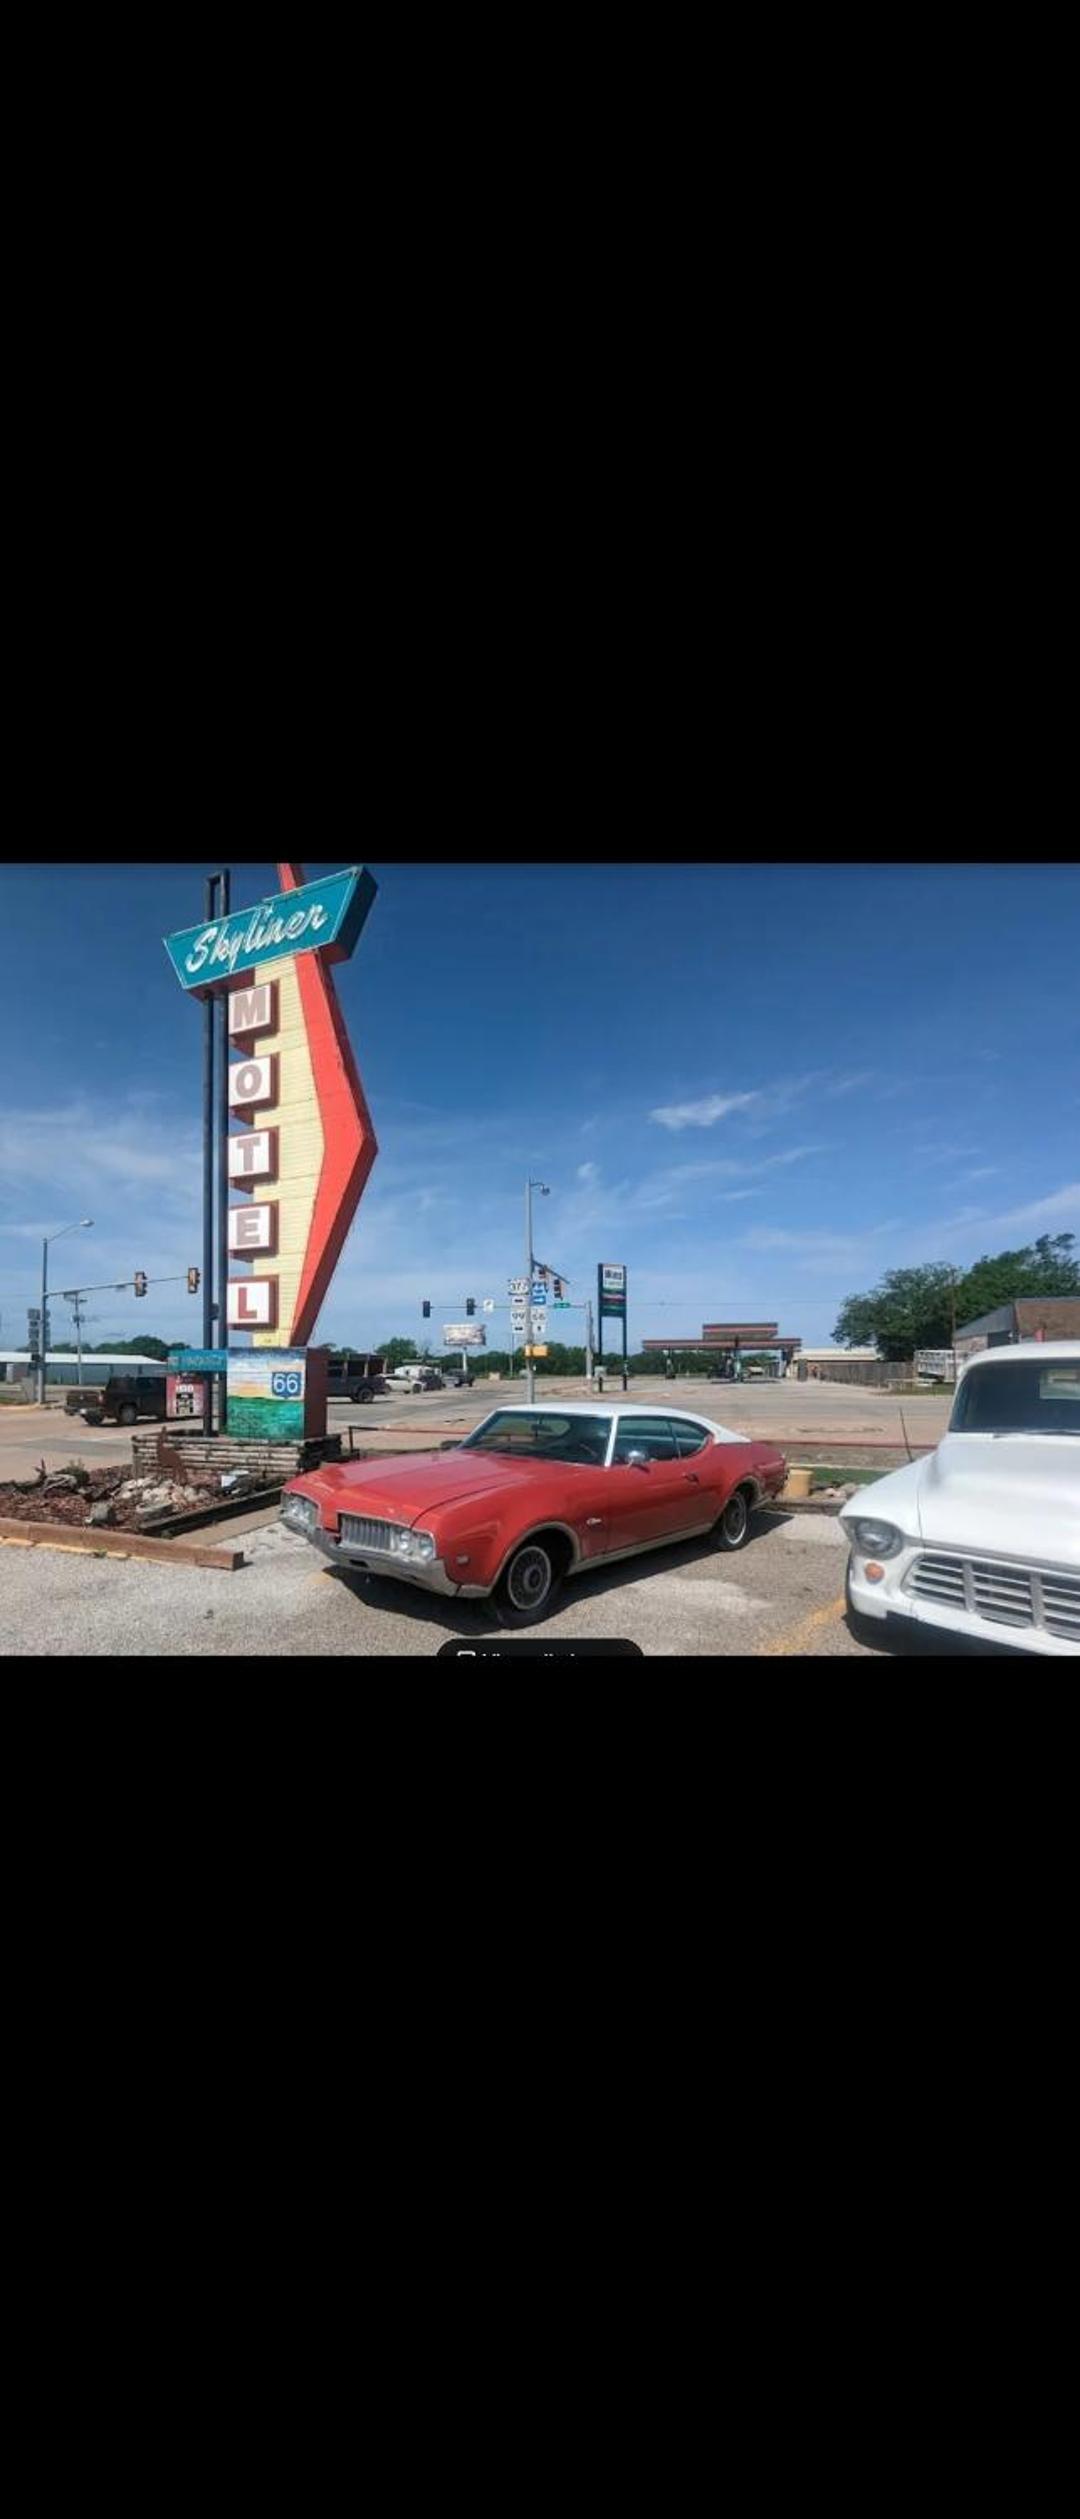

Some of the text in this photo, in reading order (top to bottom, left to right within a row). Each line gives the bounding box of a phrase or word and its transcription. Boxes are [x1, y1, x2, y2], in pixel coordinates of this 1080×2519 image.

[185, 902, 329, 975] Skyliner
[232, 989, 266, 1320] MOTEL
[273, 1373, 299, 1393] 66
